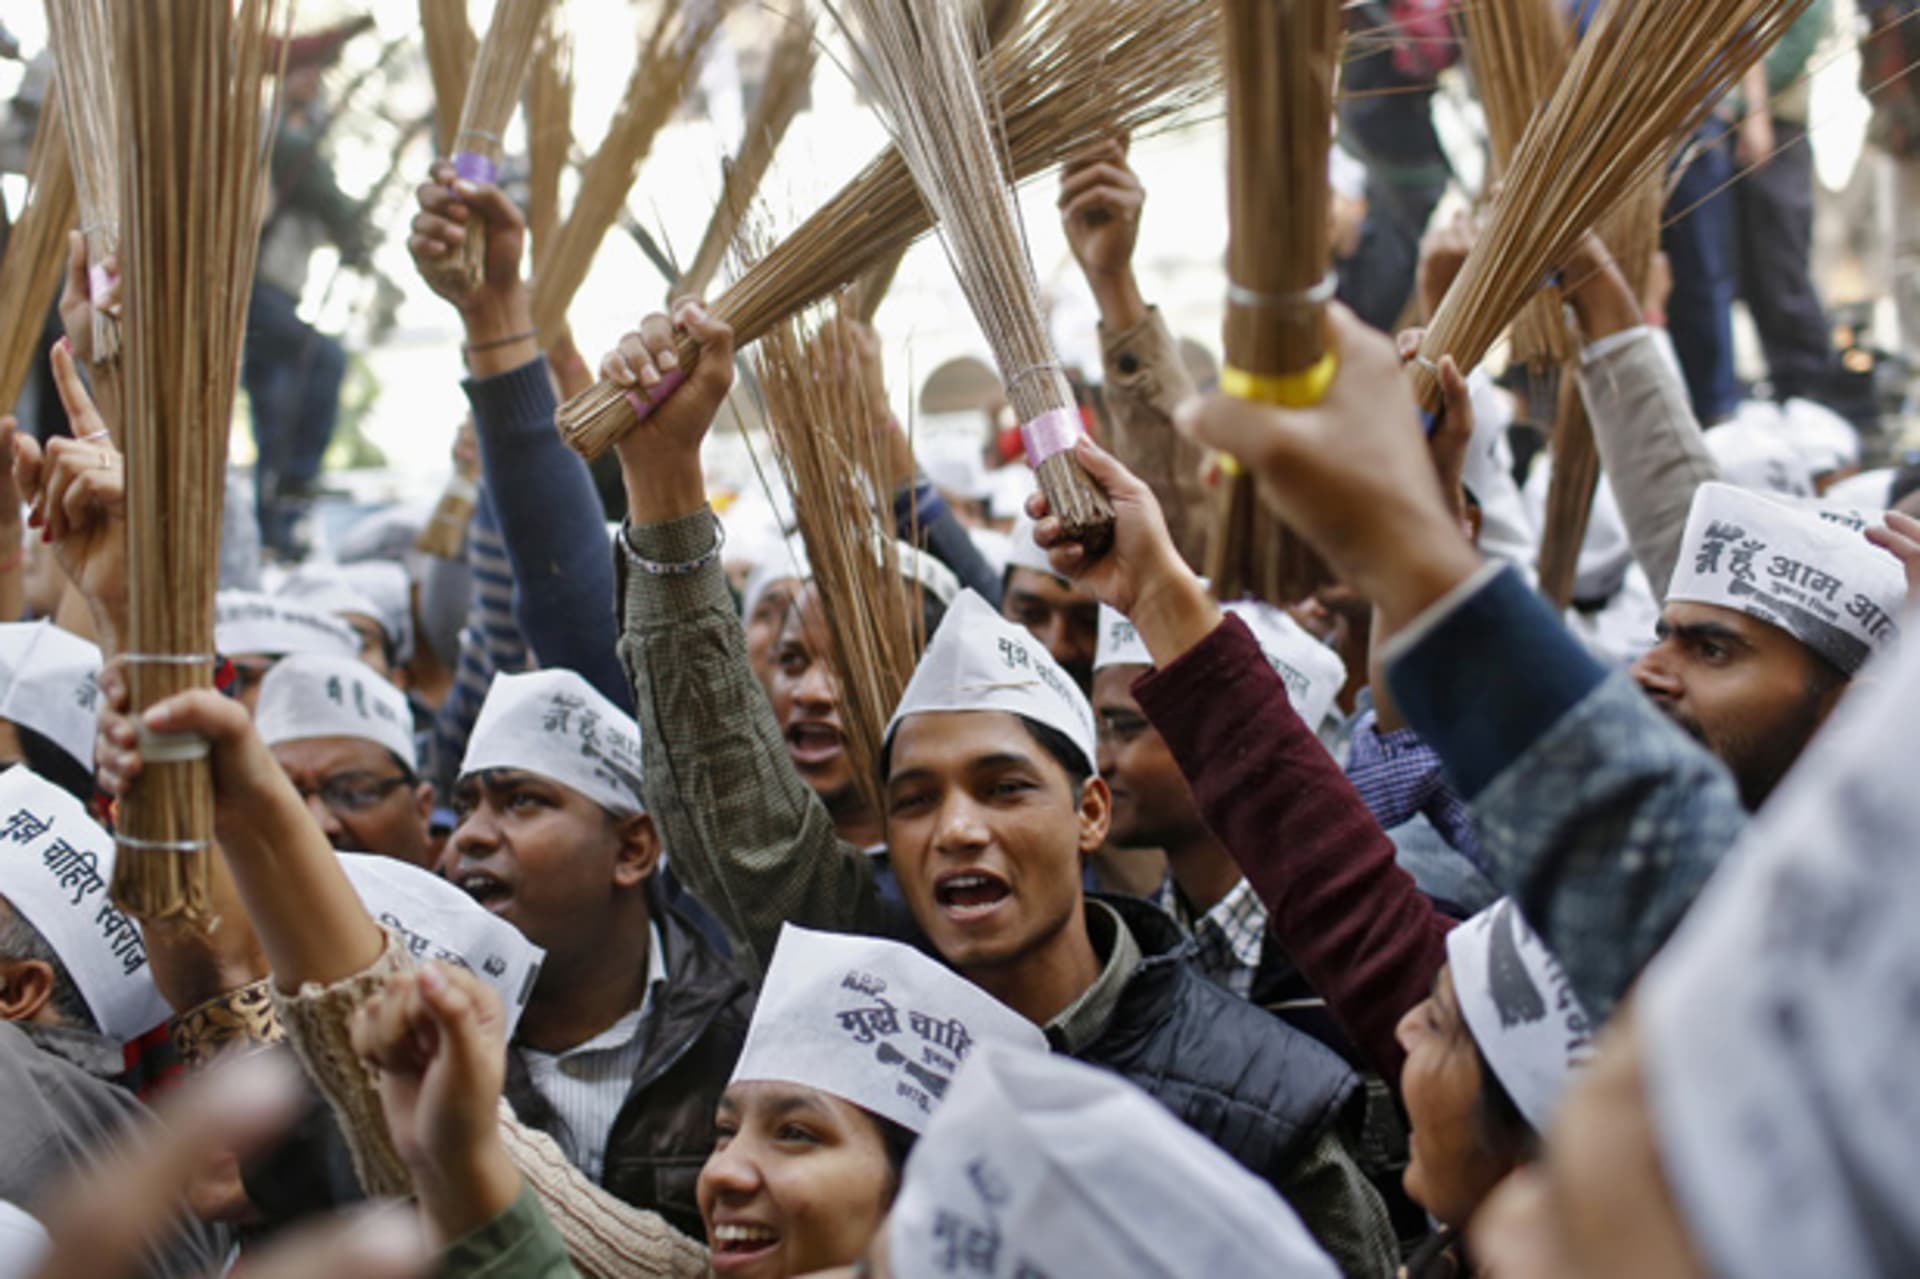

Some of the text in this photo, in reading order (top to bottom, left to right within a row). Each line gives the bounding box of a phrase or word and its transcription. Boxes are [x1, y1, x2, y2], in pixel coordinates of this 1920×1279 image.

[1766, 555, 1843, 602] आम
[0, 808, 57, 846] मुझे
[42, 836, 105, 906] चाहिए
[835, 997, 902, 1044] मुझे
